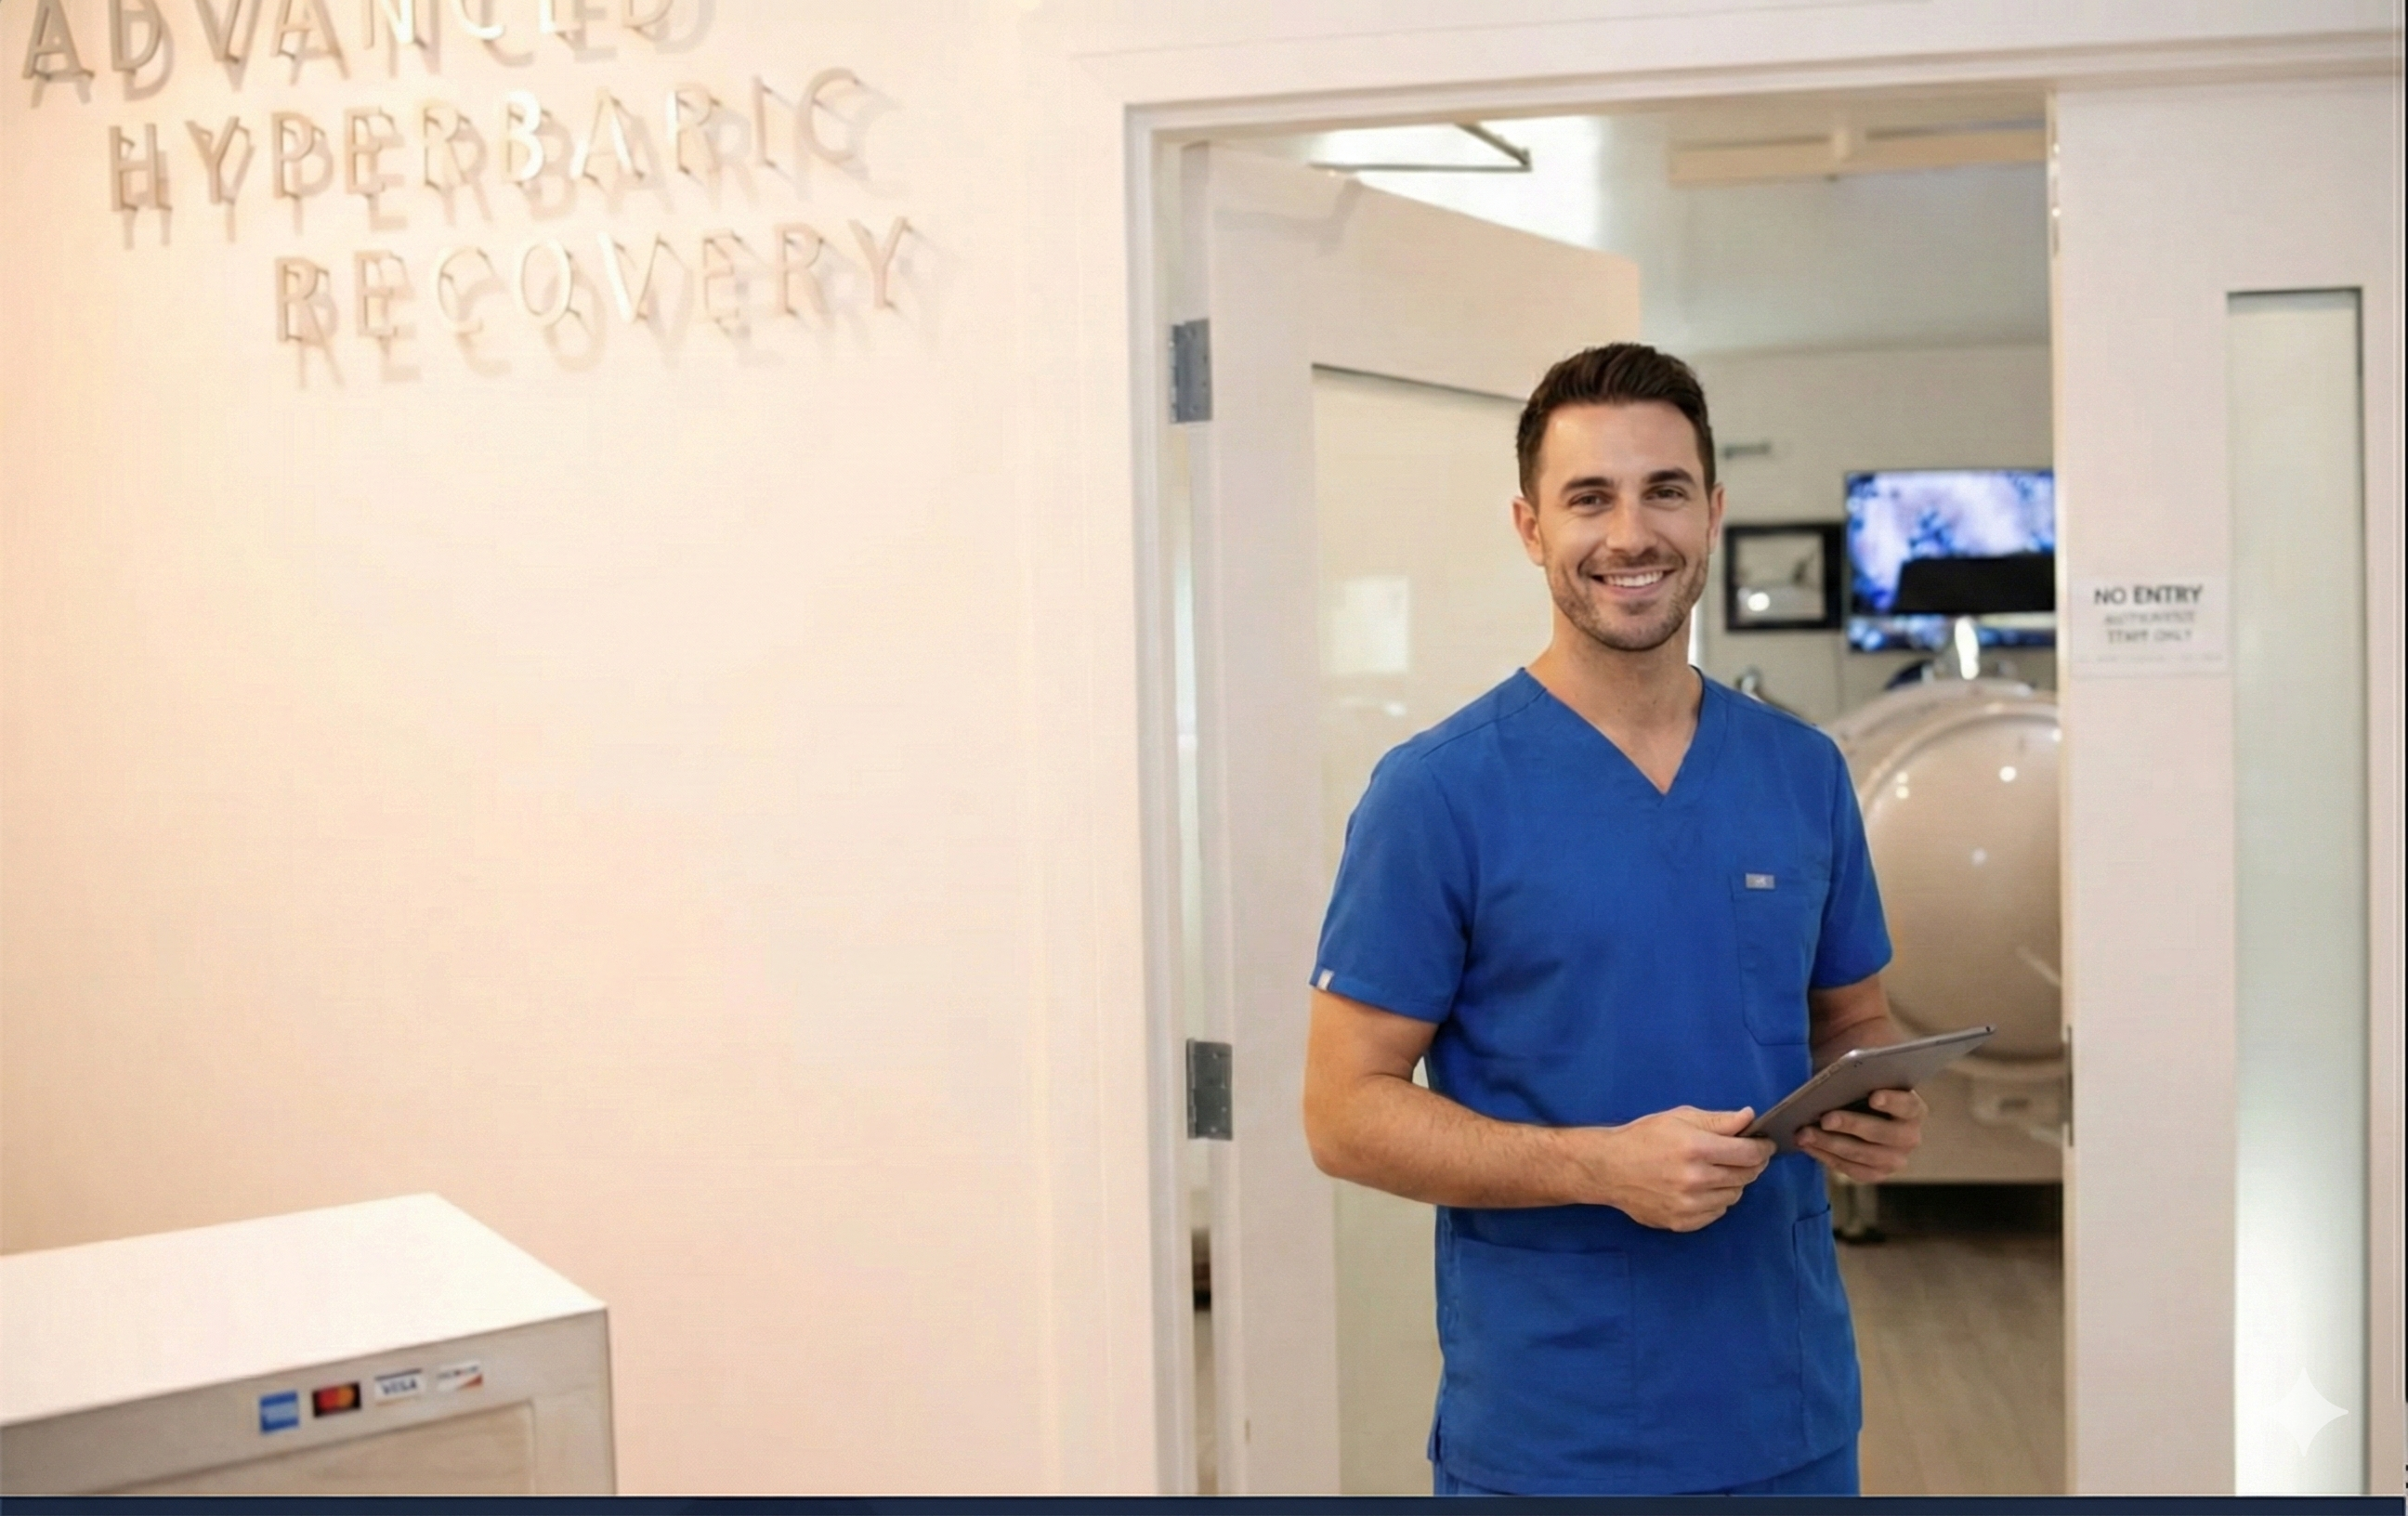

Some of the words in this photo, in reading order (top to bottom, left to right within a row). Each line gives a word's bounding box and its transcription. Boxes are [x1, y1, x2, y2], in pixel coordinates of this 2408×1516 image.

[109, 66, 860, 213] HYPERBARIC
[275, 216, 910, 342] RECOVERY
[2094, 586, 2127, 605] NO
[2134, 584, 2203, 604] ENTRY
